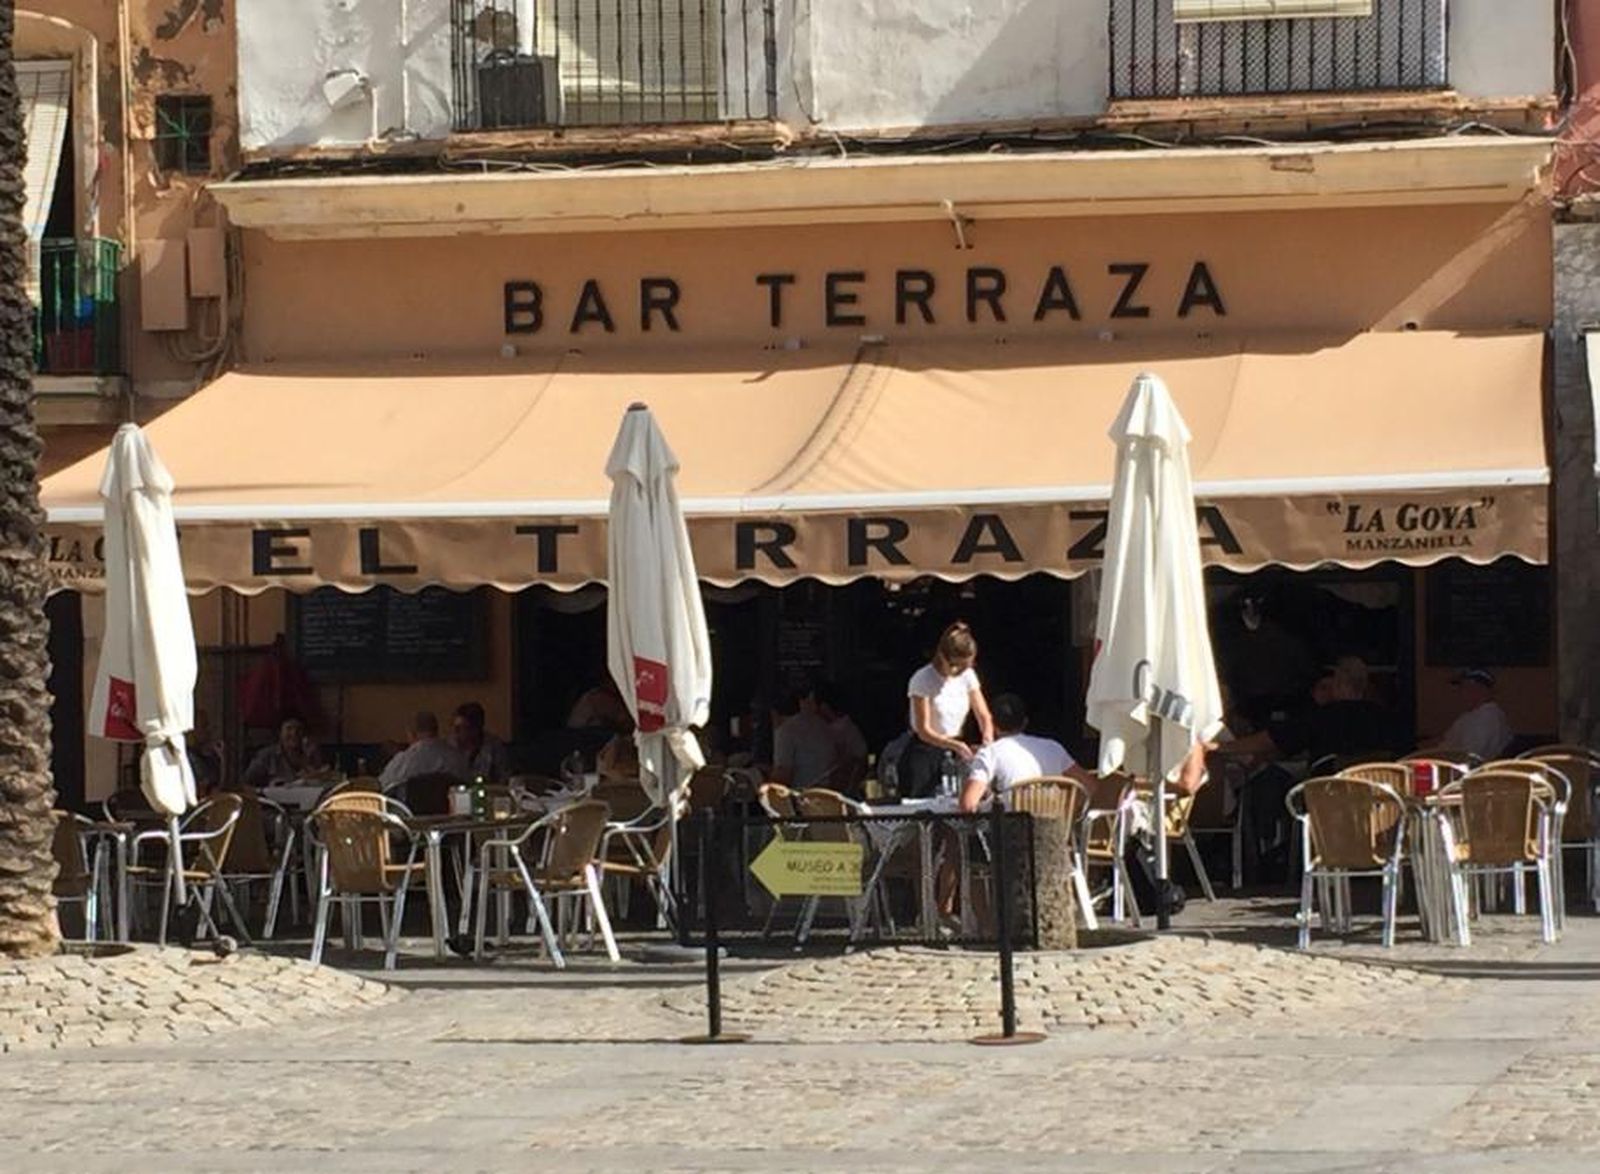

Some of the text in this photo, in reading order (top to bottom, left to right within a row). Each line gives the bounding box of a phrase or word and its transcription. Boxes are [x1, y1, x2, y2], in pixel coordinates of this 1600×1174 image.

[504, 261, 1227, 334] BAR TERRAZA
[252, 506, 1244, 576] EL TRRAZA
